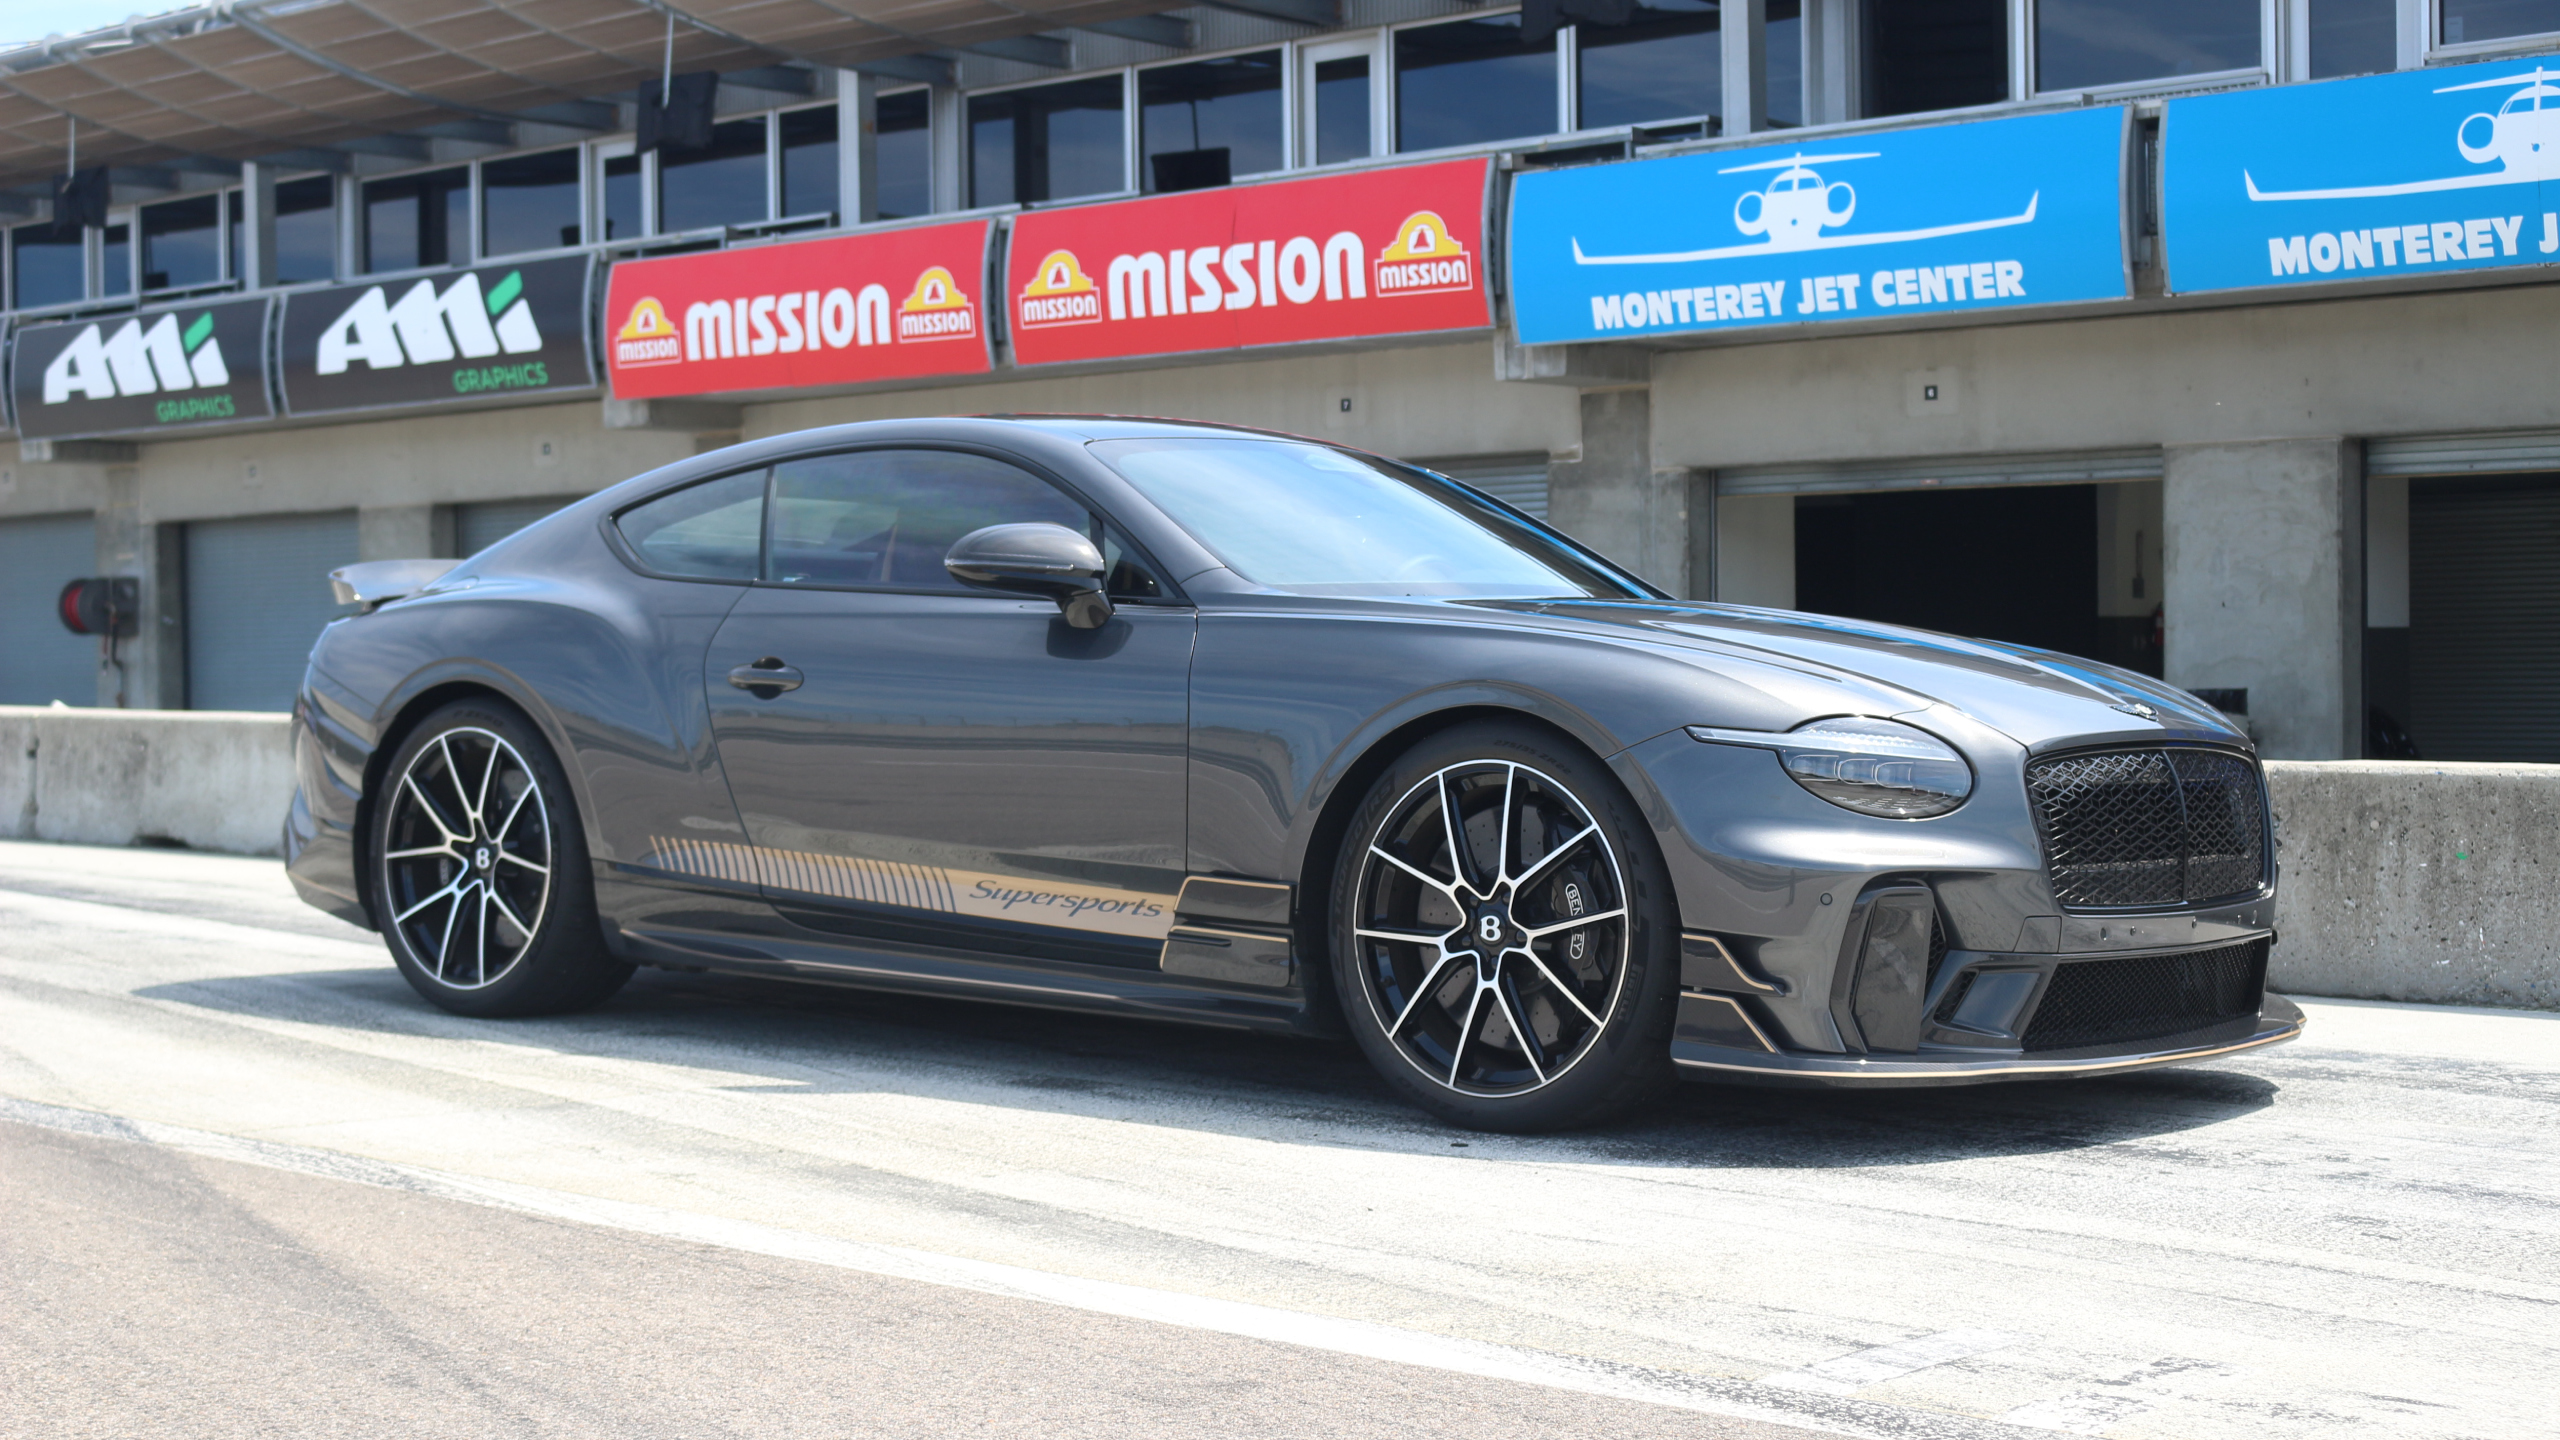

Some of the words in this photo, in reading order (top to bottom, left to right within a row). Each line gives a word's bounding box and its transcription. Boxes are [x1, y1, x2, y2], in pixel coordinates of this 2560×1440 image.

[2269, 215, 2524, 277] MONTEREY
[1108, 231, 1367, 321] MISSION
[1379, 259, 1468, 290] MISSION
[1023, 294, 1098, 322] MISSION
[1591, 281, 1785, 330] MONTEREY
[1797, 274, 1860, 314] JET
[1872, 260, 2027, 307] CENTER
[685, 284, 892, 361] MISSION
[901, 311, 972, 336] MISSION
[618, 337, 678, 361] MISSION
[452, 362, 549, 393] GRAPHICS
[155, 395, 236, 423] GRAPHICS
[969, 880, 1164, 917] Supersports
[1480, 915, 1501, 942] B
[1567, 889, 1583, 951] BENEY
